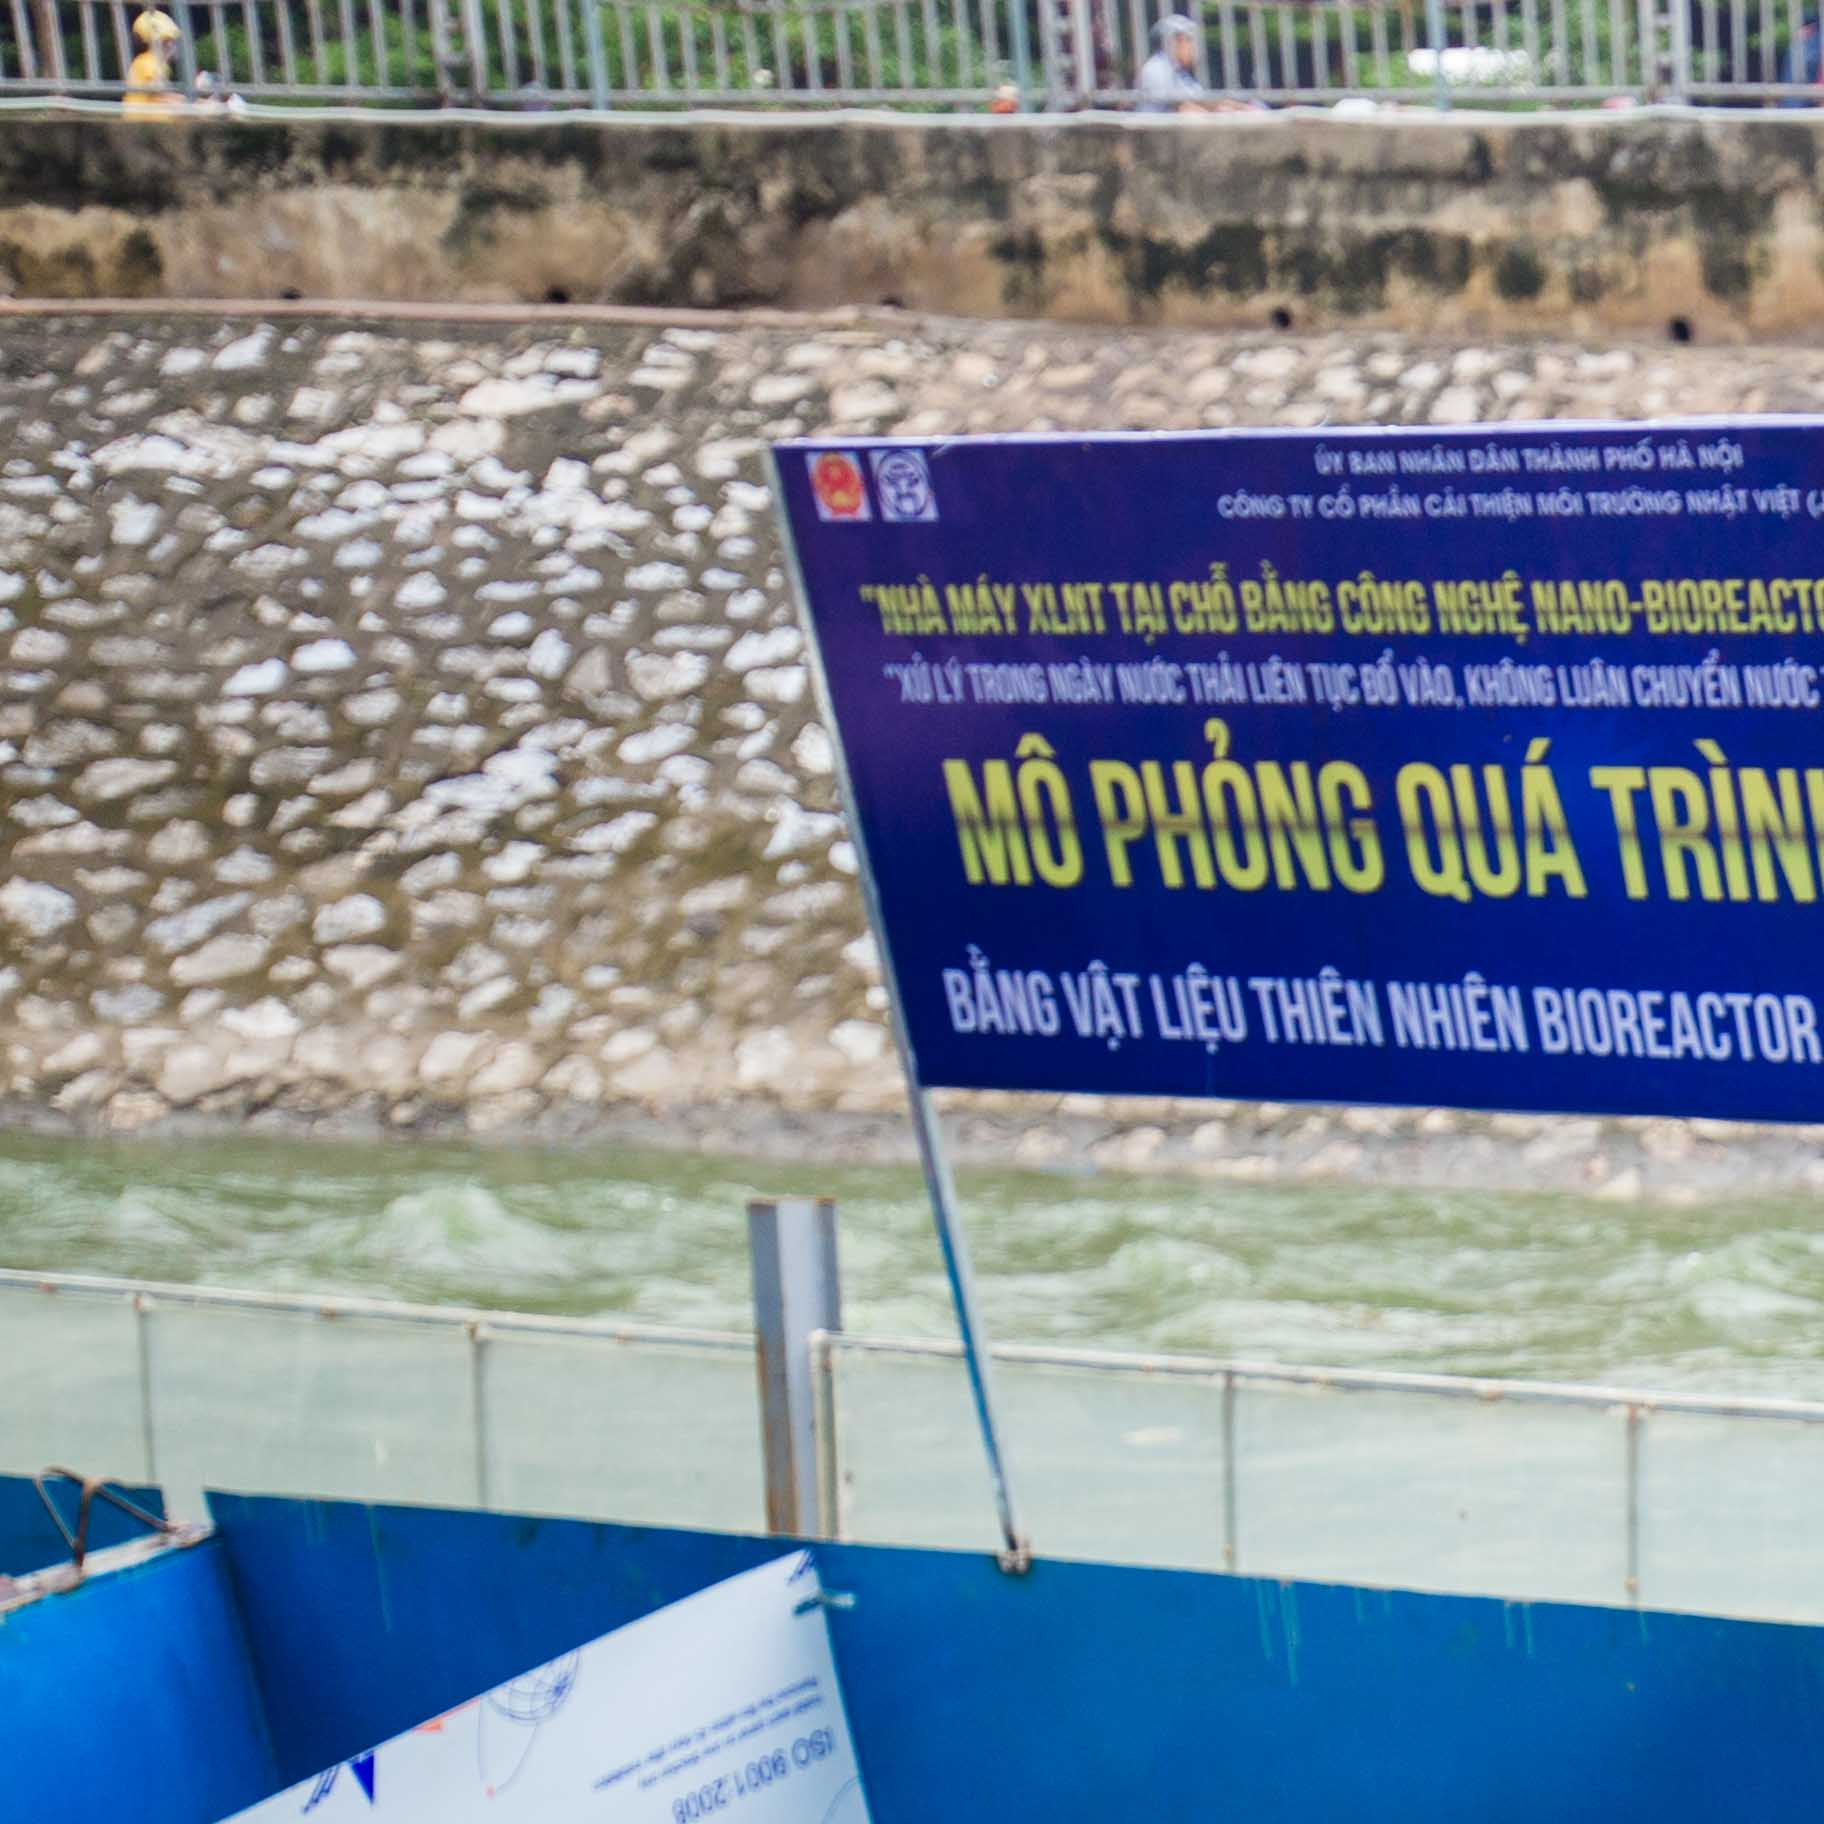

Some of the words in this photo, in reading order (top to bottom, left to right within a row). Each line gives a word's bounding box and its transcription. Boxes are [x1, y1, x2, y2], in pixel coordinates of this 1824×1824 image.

[945, 573, 1017, 635] MÁY
[1022, 581, 1106, 635] XLNT
[1109, 581, 1168, 643] TẠI
[1169, 560, 1239, 635] CHỖ
[1239, 559, 1334, 634] BẰNG
[1336, 569, 1431, 634] CÔNG
[1432, 569, 1530, 645] NGHỆ
[932, 656, 964, 704] LÝ
[964, 662, 1049, 704] TRONG
[1048, 655, 1116, 704] NGÀY
[1116, 655, 1187, 704] NƯỚC
[1184, 650, 1249, 704] THẢI
[1247, 654, 1306, 704] LIÊN
[1305, 662, 1360, 713] TỤC
[1359, 648, 1399, 706] ĐỔ
[1398, 656, 1465, 710] VÀO,
[1463, 656, 1555, 707] KHÔNG
[1556, 656, 1630, 707] LUÂN
[1631, 648, 1742, 708] CHUYỂN
[1742, 656, 1820, 708] NƯỚC
[942, 734, 1085, 887] MÔ
[1089, 719, 1386, 892] PHỎNG
[1397, 739, 1587, 902] QUÁ
[943, 944, 1060, 1036] BẰNG
[1061, 960, 1143, 1050] VẬT
[1150, 963, 1247, 1053] LIỆU
[1250, 966, 1383, 1047] THIÊN
[1388, 972, 1529, 1055] NHIÊN
[1533, 986, 1822, 1063] BIOREACTOR
[792, 1725, 835, 1769] ISO
